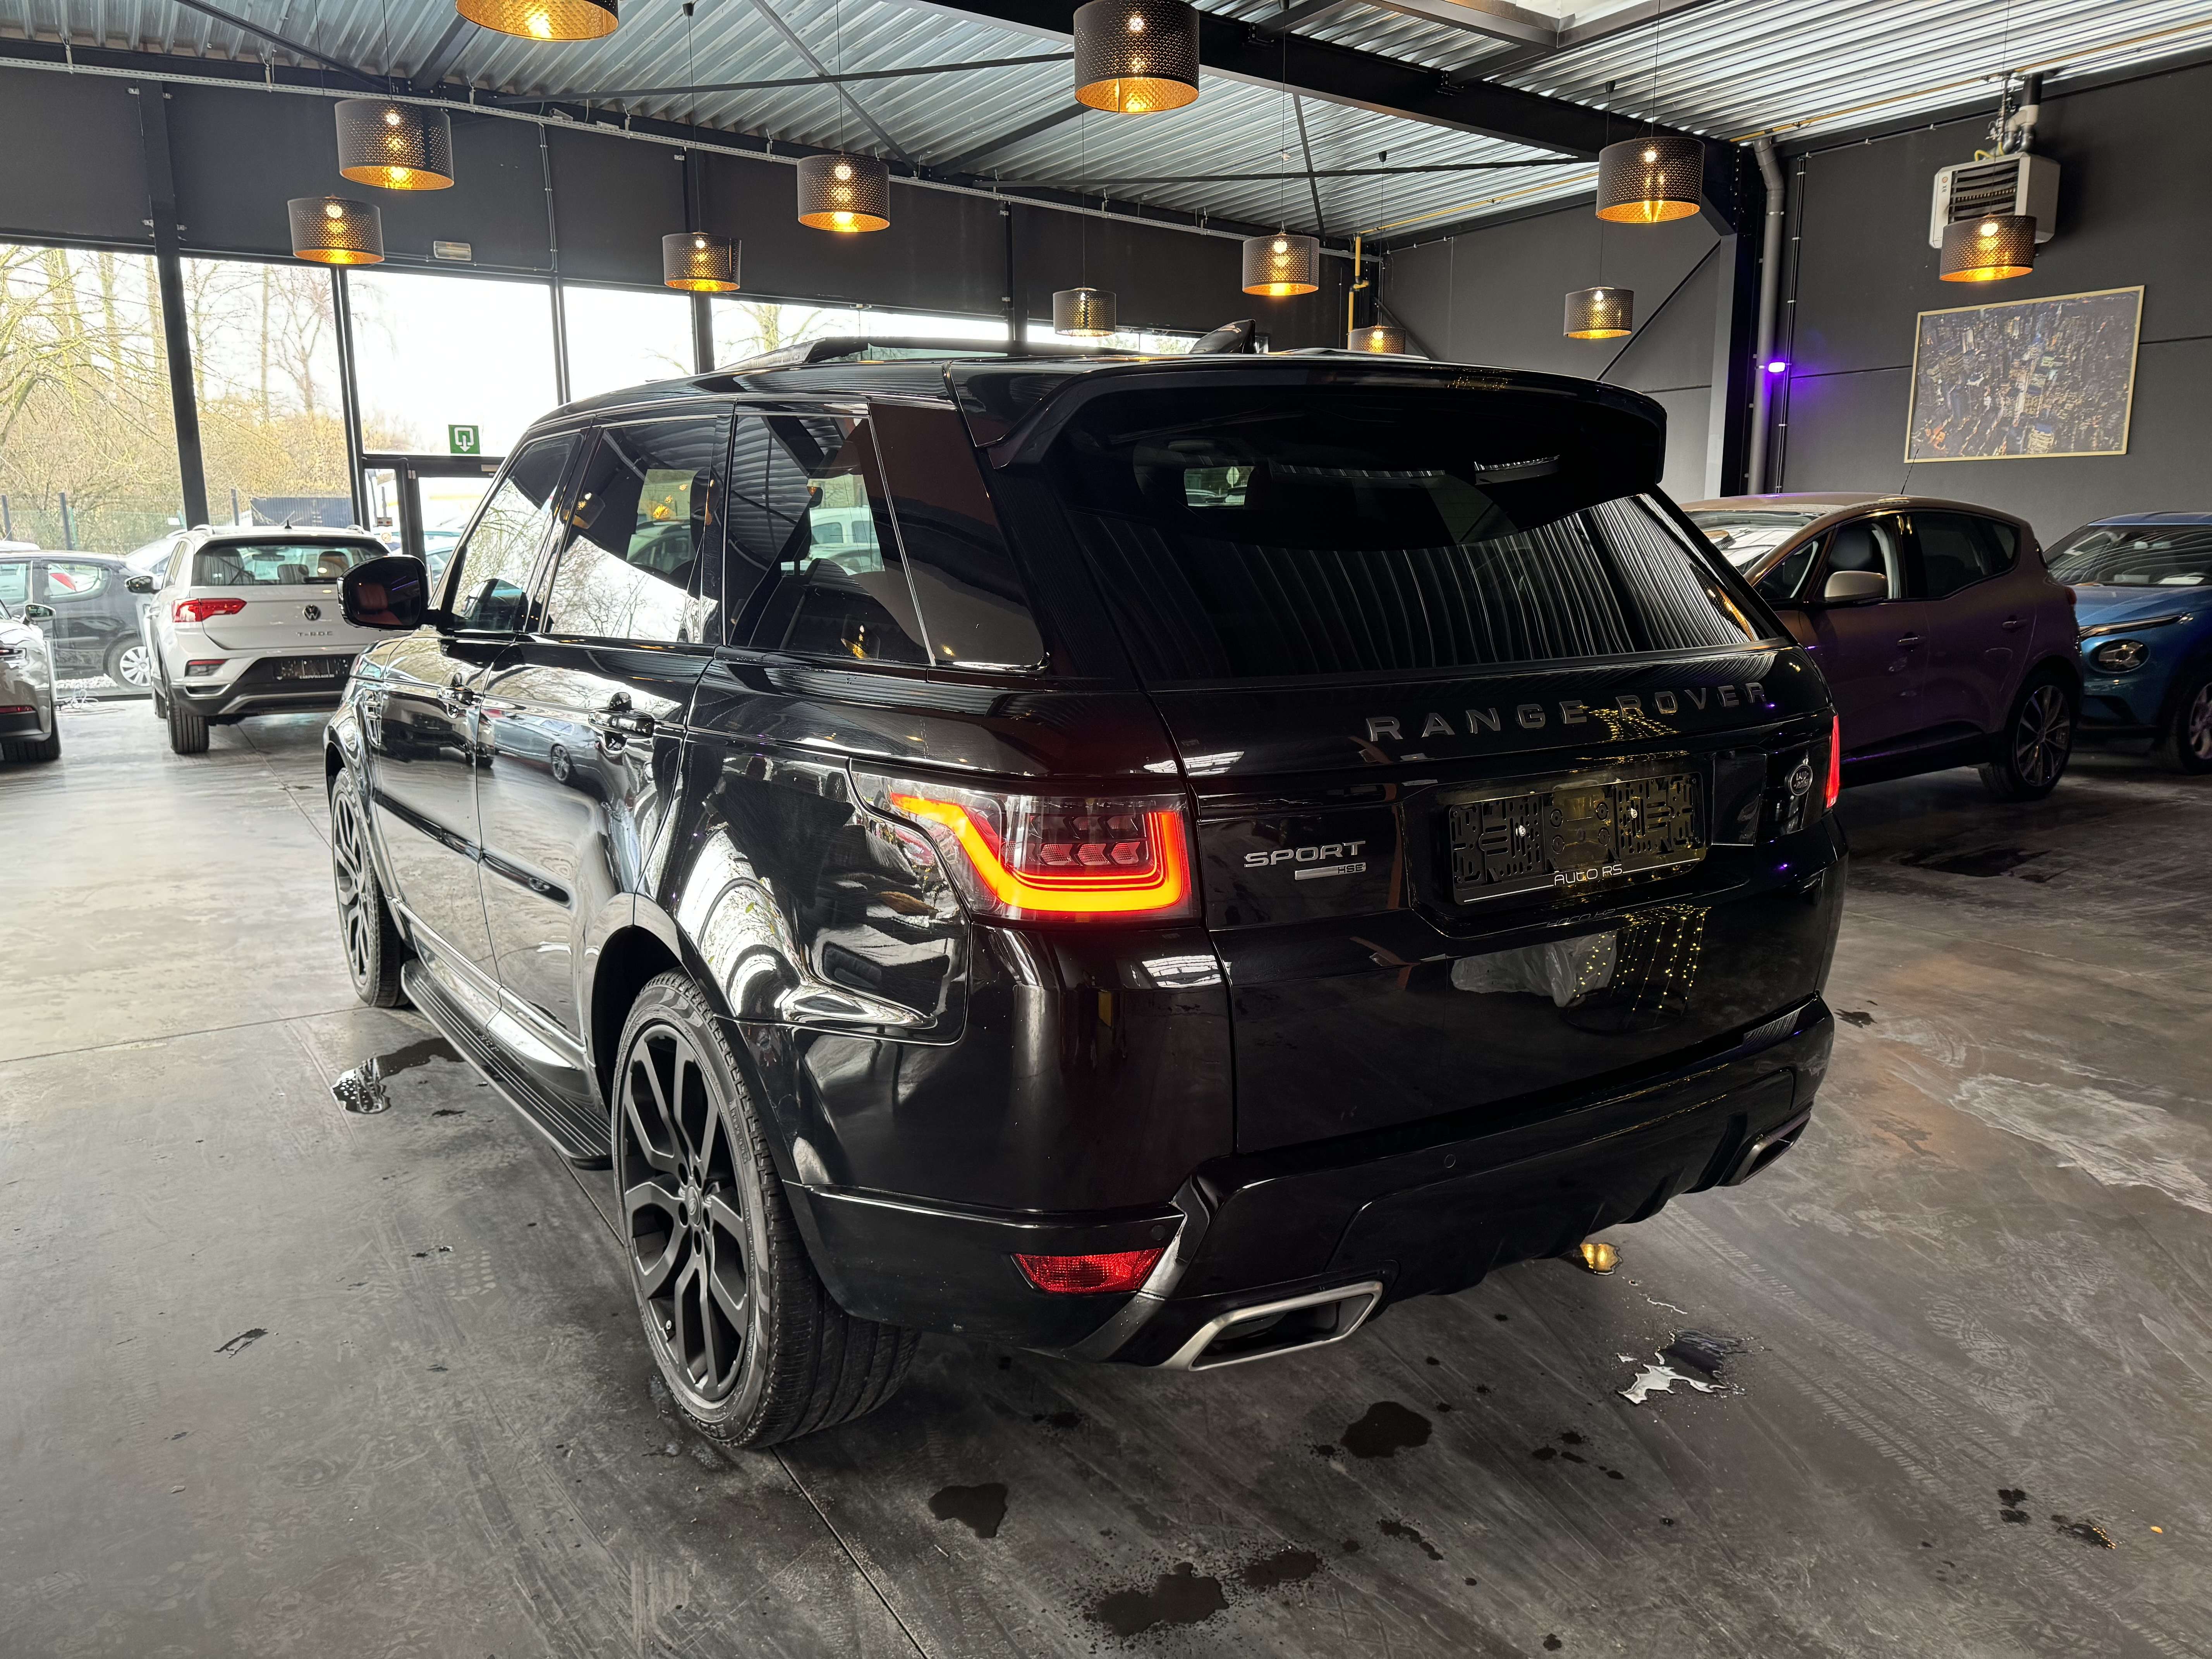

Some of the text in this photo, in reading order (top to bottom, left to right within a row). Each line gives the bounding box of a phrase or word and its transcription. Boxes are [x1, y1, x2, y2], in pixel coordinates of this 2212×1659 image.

[1366, 682, 1769, 741] RANGE ROVER
[1244, 841, 1366, 867] SPORT
[1338, 864, 1364, 874] HSE
[1602, 864, 1623, 877] RS
